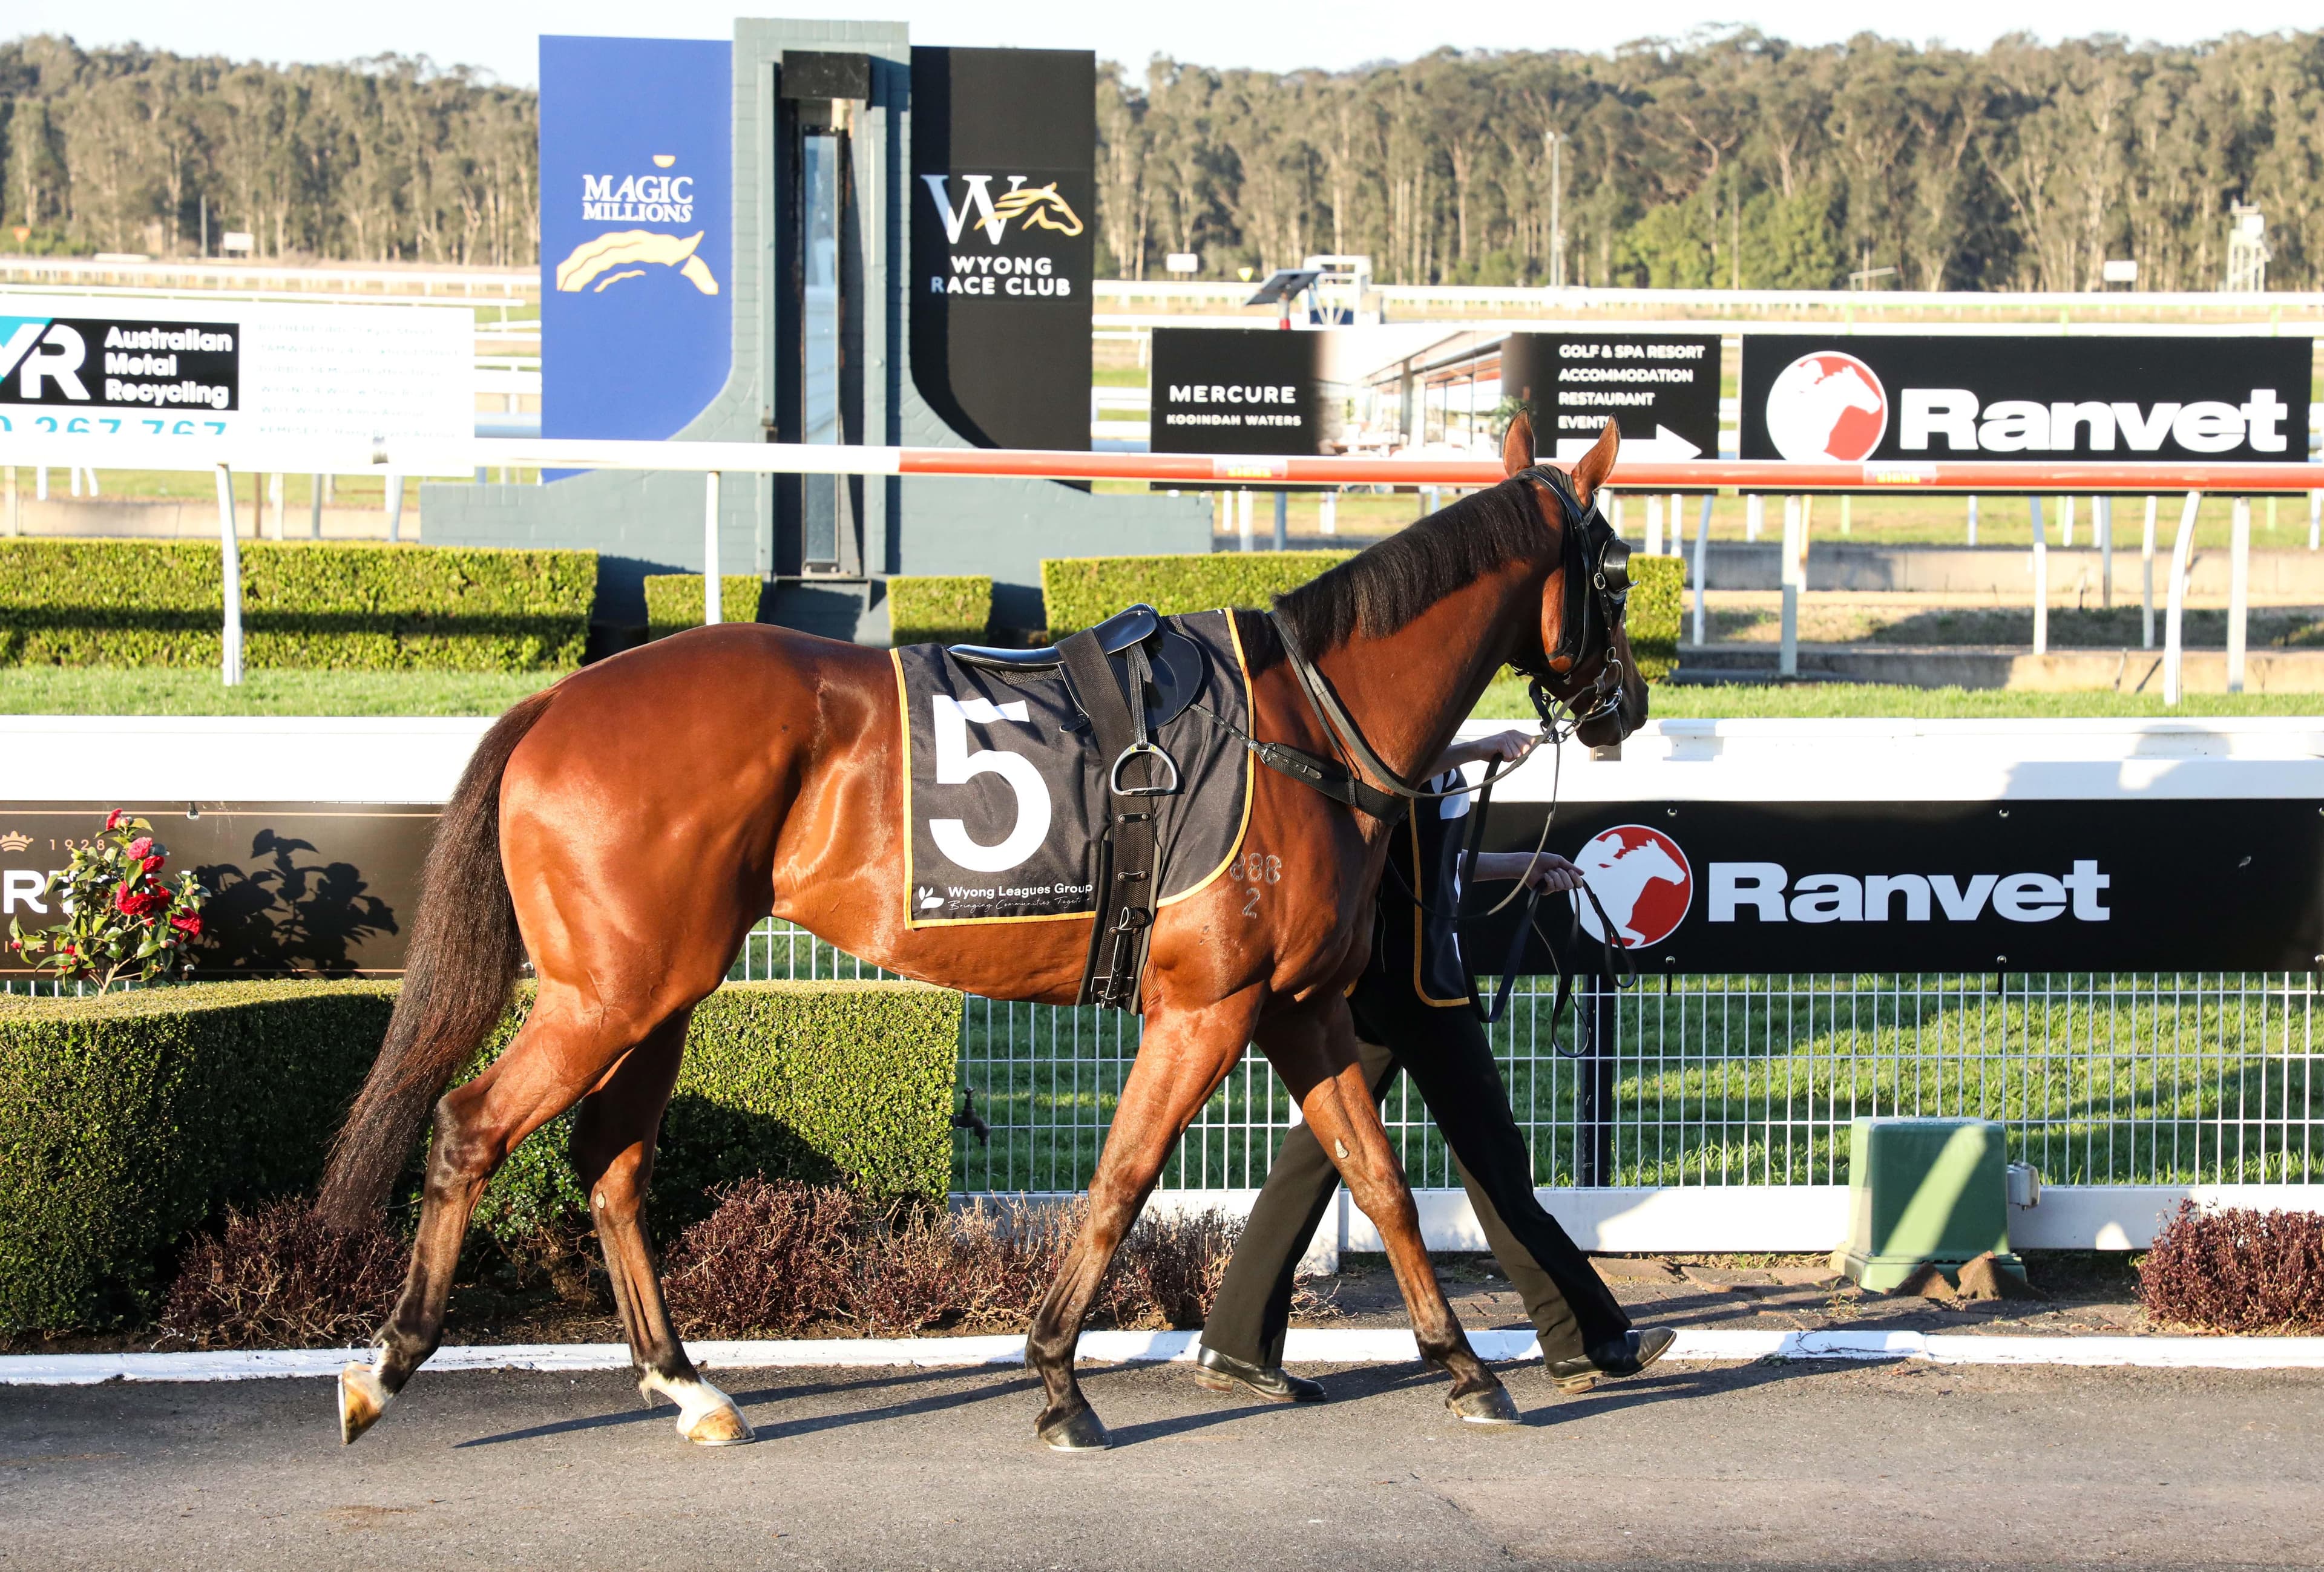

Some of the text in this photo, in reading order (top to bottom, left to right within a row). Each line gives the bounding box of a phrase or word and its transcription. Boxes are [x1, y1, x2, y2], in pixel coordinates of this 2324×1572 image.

[582, 174, 694, 204] MAGIC
[582, 202, 694, 223] MILLIONS
[951, 256, 1052, 275] WYONG
[931, 276, 1071, 296] RACE CLUB
[104, 326, 233, 352] Australian
[1558, 344, 1705, 358] GOLF & SPA RESORT
[105, 352, 177, 376] Metal
[1558, 368, 1694, 382] ACCOMMODATION
[105, 379, 229, 410] Recycling
[1169, 385, 1296, 404] MERCURE
[1558, 392, 1655, 405] RESTAURANT
[1166, 414, 1302, 427] KOOINDAH WATERS
[1900, 389, 2288, 453] Ranvet
[928, 695, 1052, 873] 5
[49, 839, 105, 850] 1928
[948, 883, 1093, 900] Wyong Leagues Group
[1709, 860, 2110, 923] Ranvet
[948, 900, 993, 914] Bringing
[1242, 888, 1261, 919] 2
